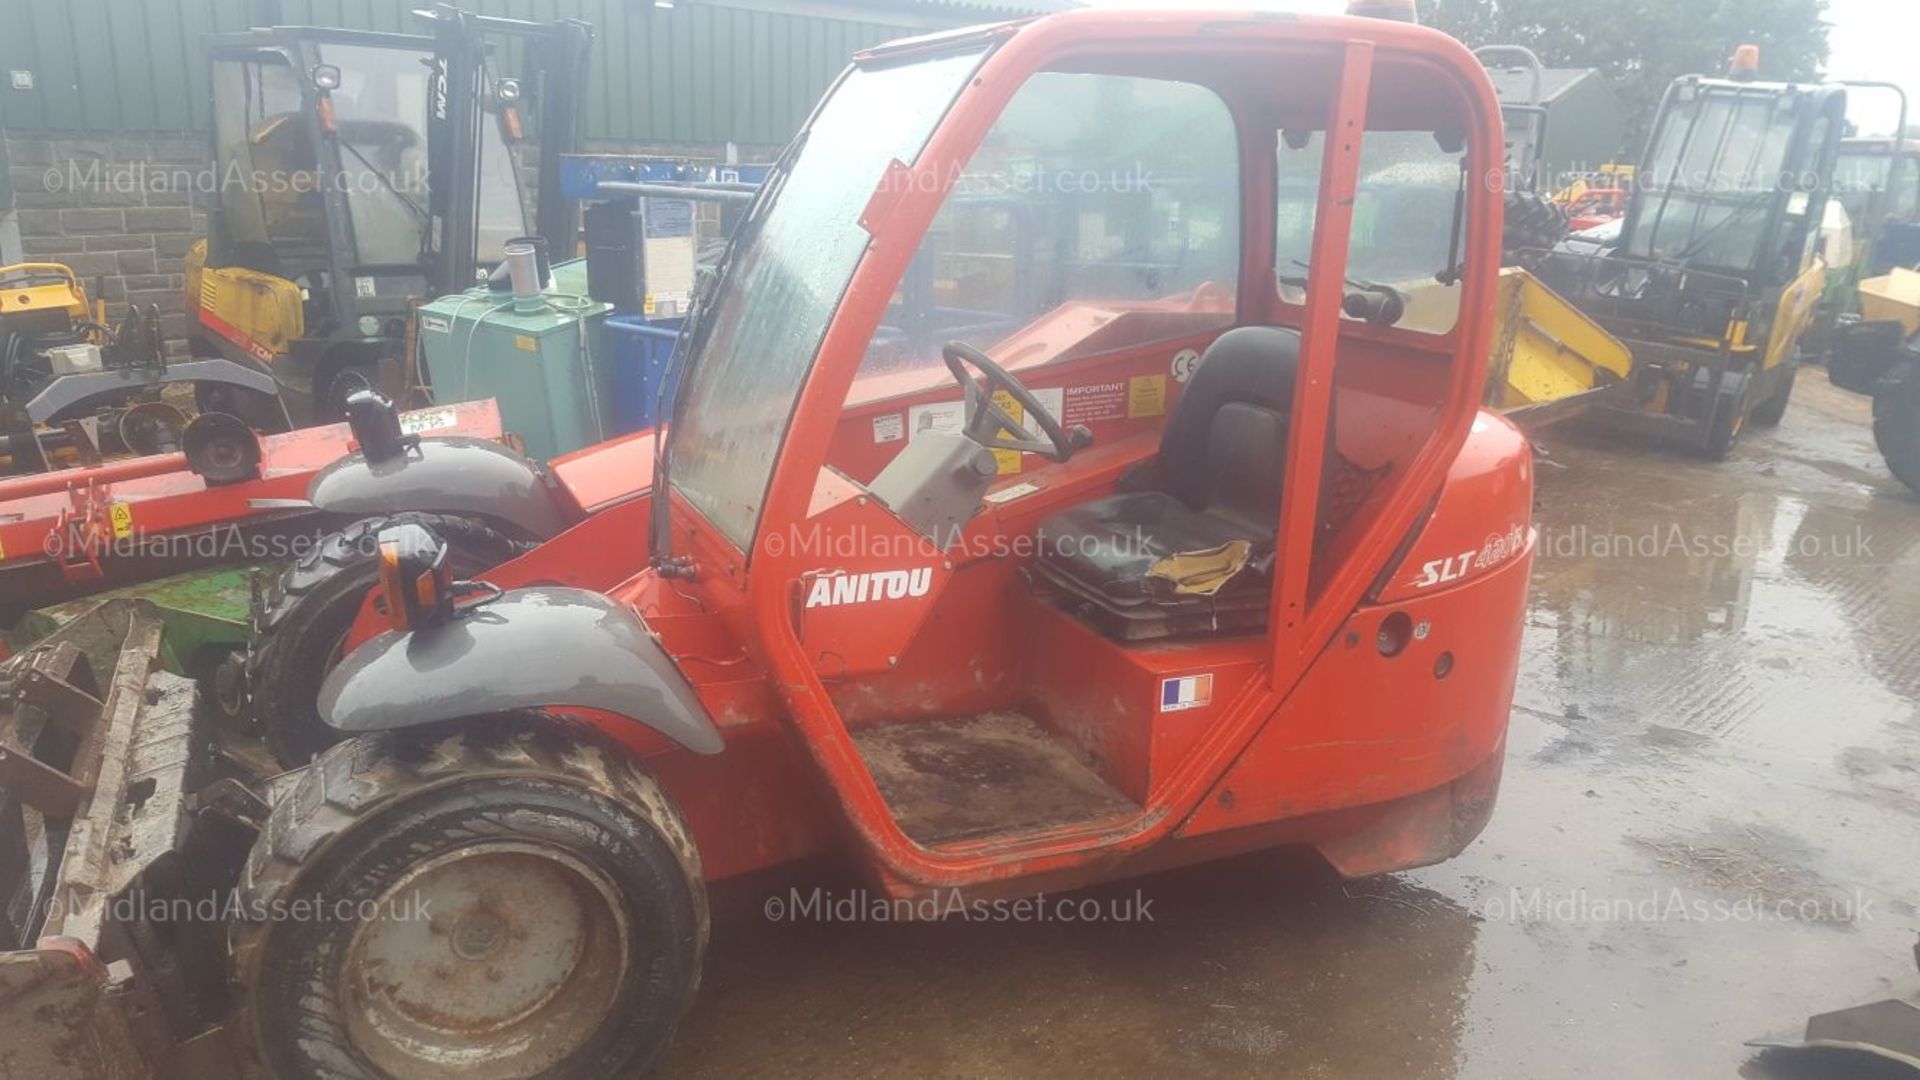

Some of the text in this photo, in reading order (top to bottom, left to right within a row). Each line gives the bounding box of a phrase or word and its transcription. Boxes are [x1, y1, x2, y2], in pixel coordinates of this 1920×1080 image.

[437, 58, 448, 119] TCM
[1066, 382, 1126, 396] IMPORTANT
[805, 567, 933, 608] ANITOU
[1416, 550, 1477, 588] SLT
